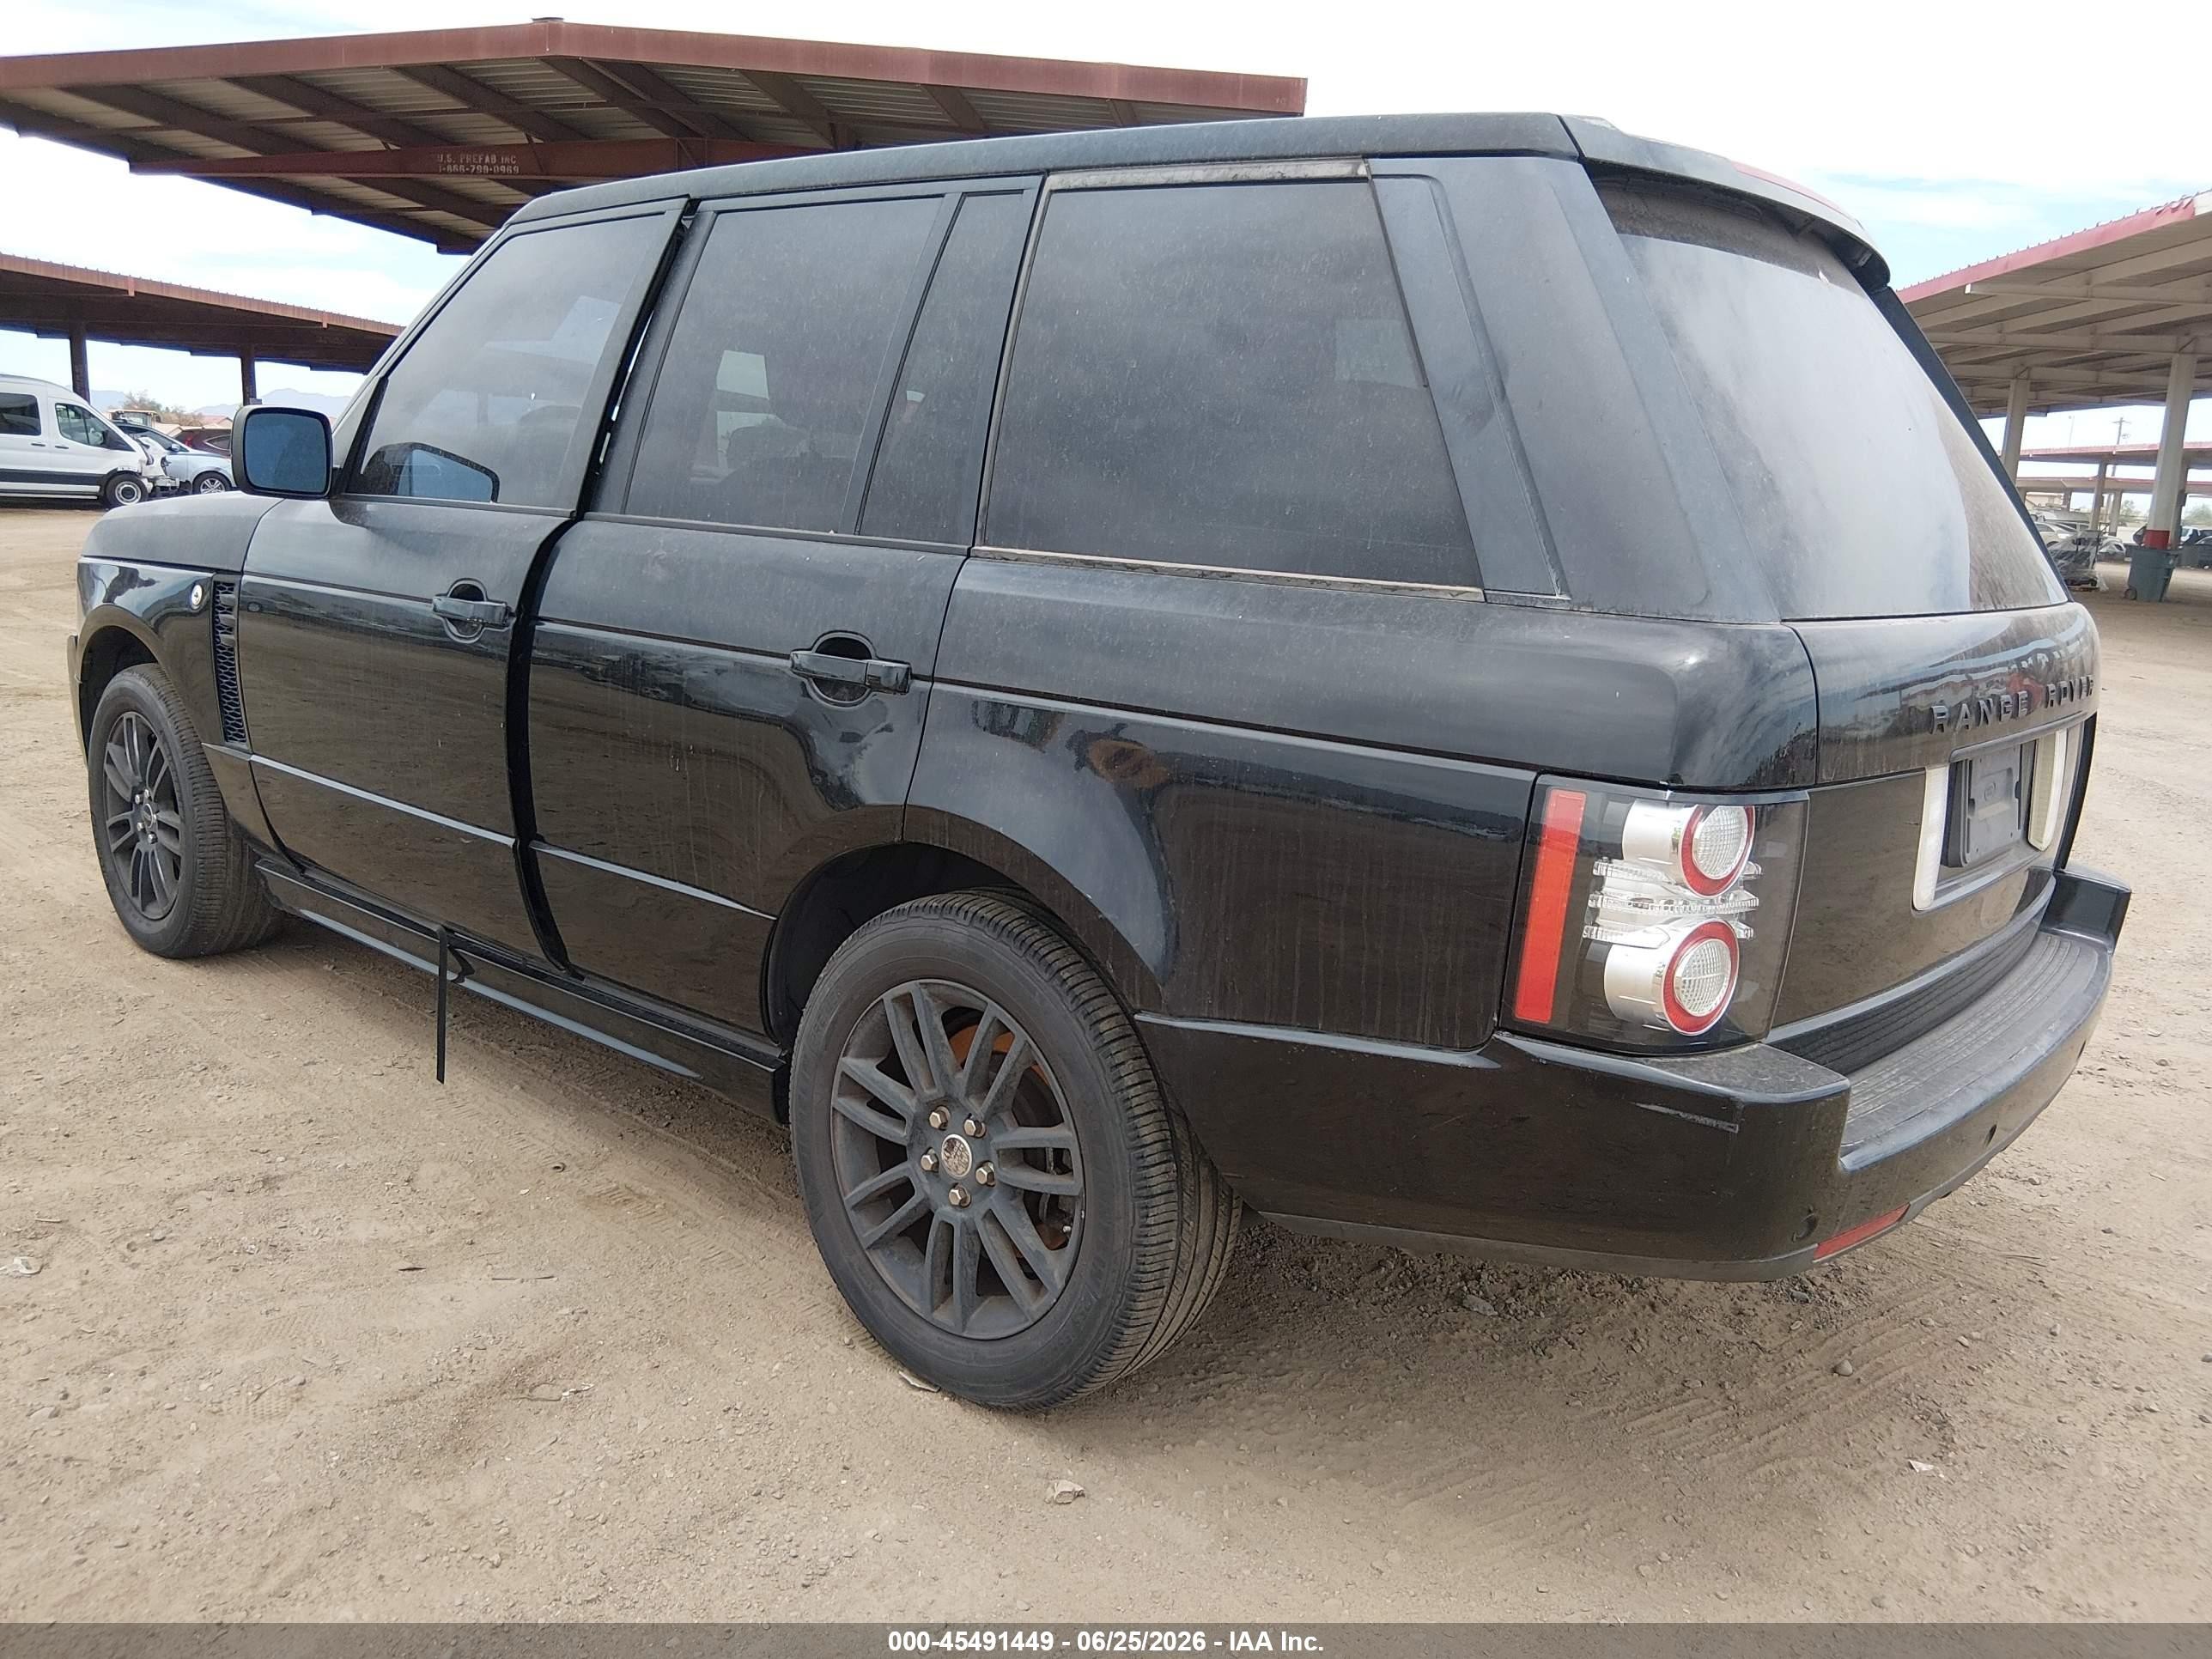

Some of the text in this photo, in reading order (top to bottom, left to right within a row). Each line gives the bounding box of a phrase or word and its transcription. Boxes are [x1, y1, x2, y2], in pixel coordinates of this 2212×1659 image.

[437, 154, 517, 164] U.S. PREFAB INC
[1930, 675, 2094, 735] RANGE ROVER
